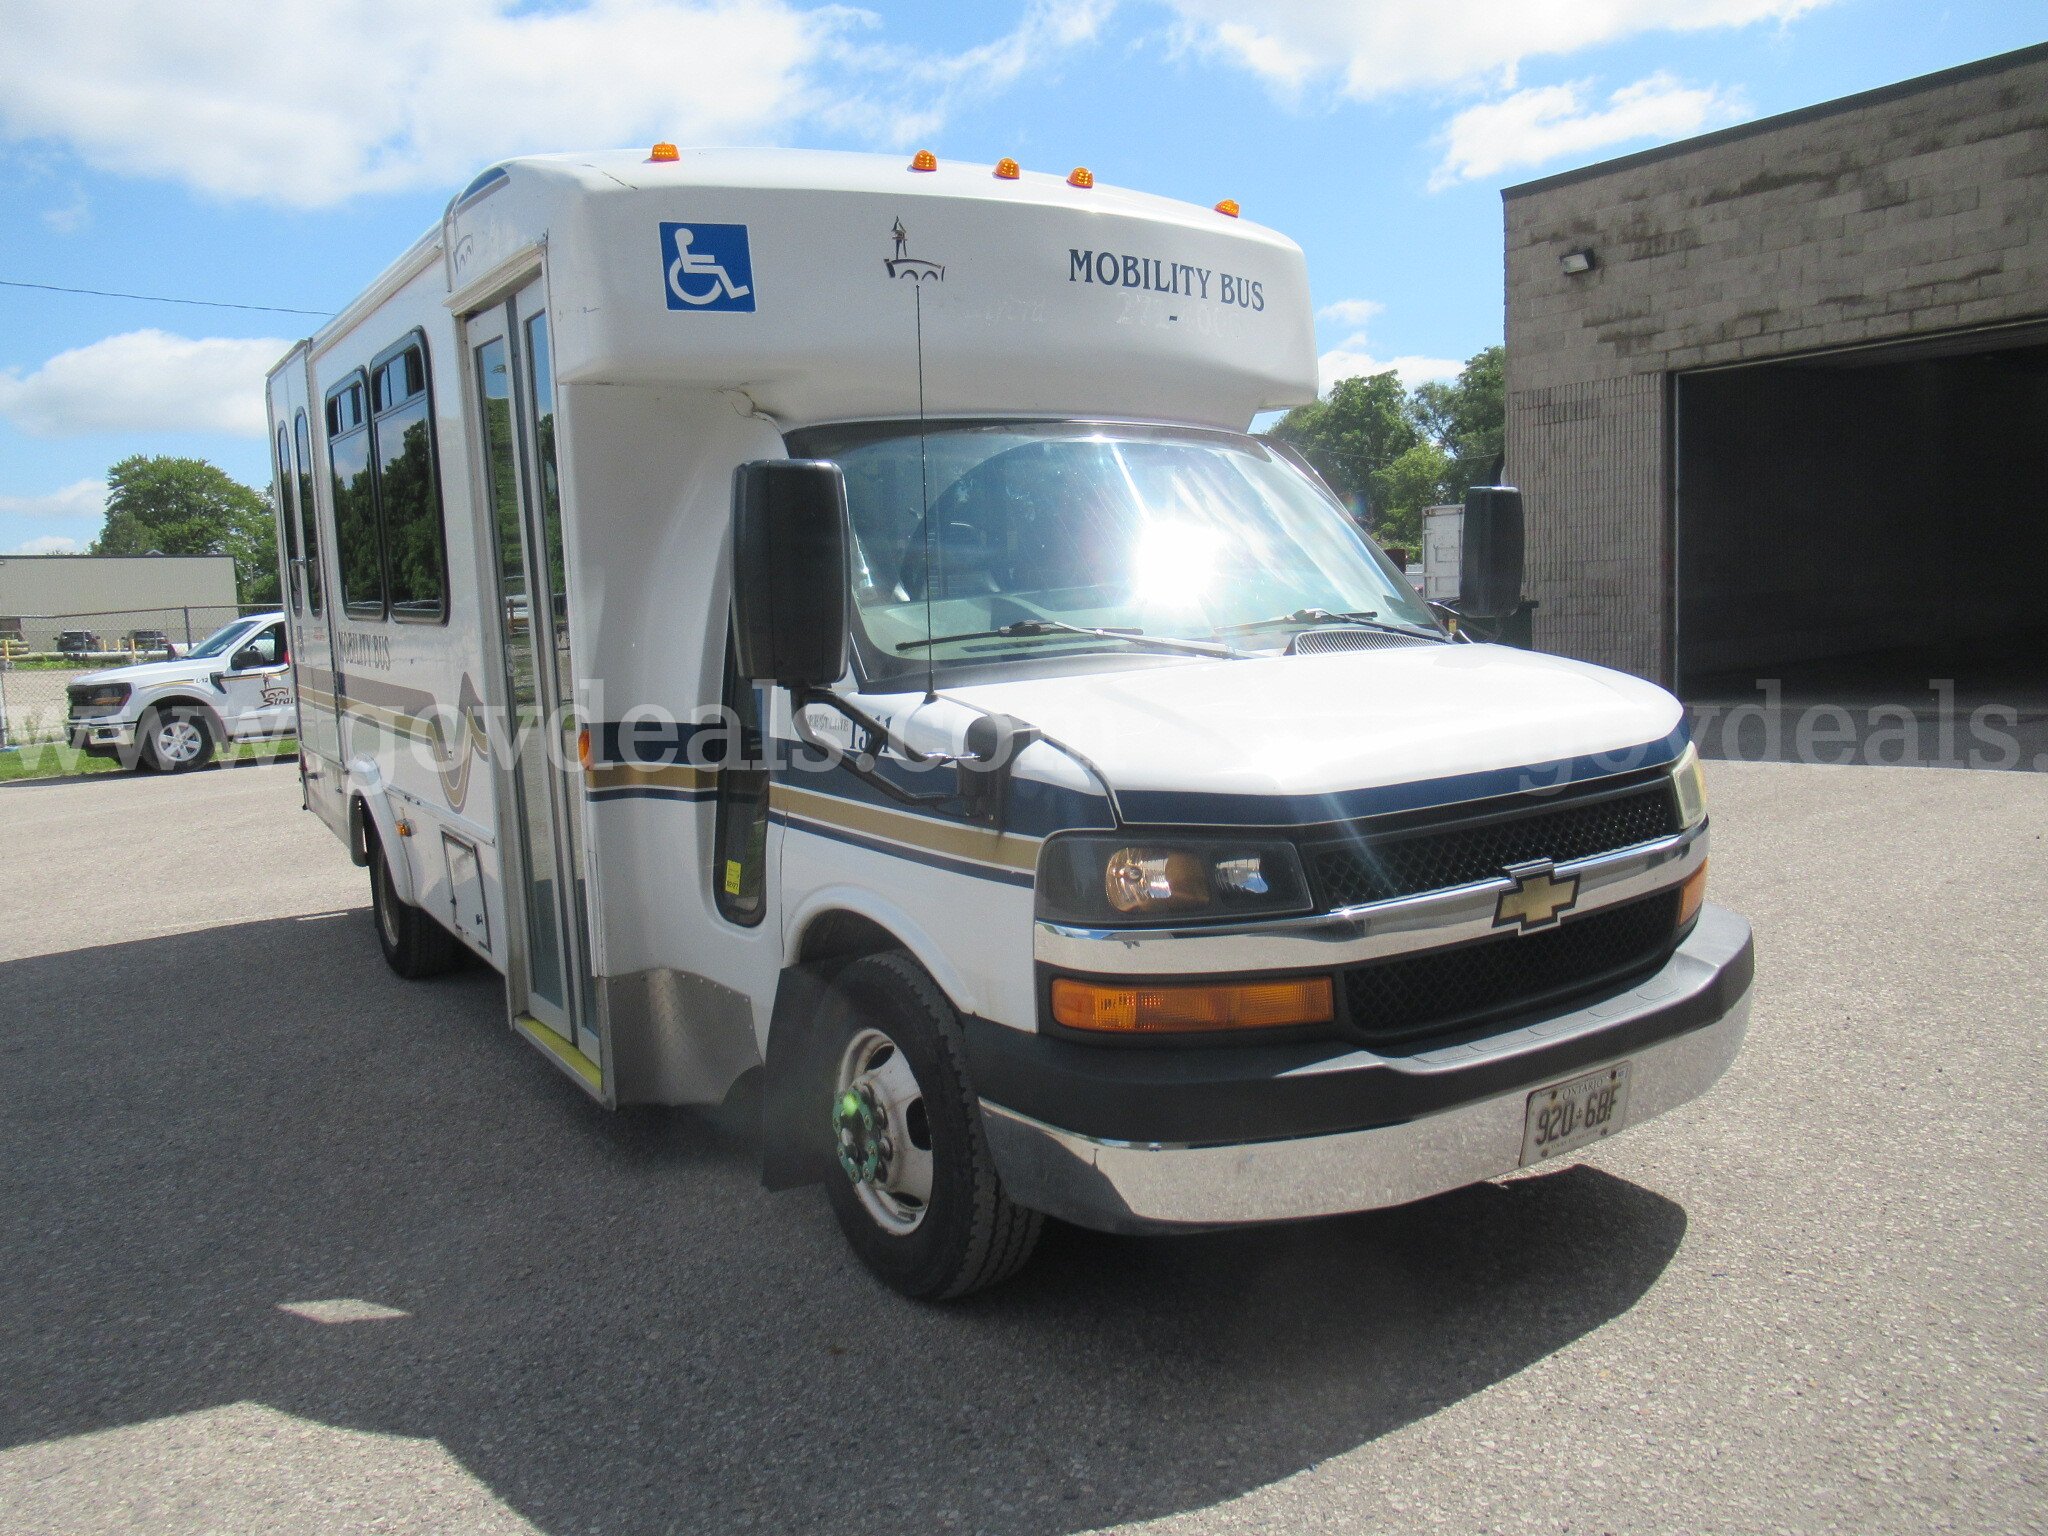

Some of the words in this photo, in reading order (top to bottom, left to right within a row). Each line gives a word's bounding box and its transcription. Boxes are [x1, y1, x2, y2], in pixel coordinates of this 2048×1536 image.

[1069, 249, 1211, 299] MOBILITY
[1220, 273, 1265, 312] BUS
[373, 635, 391, 671] BUS
[1562, 1078, 1604, 1101] ONTARIO
